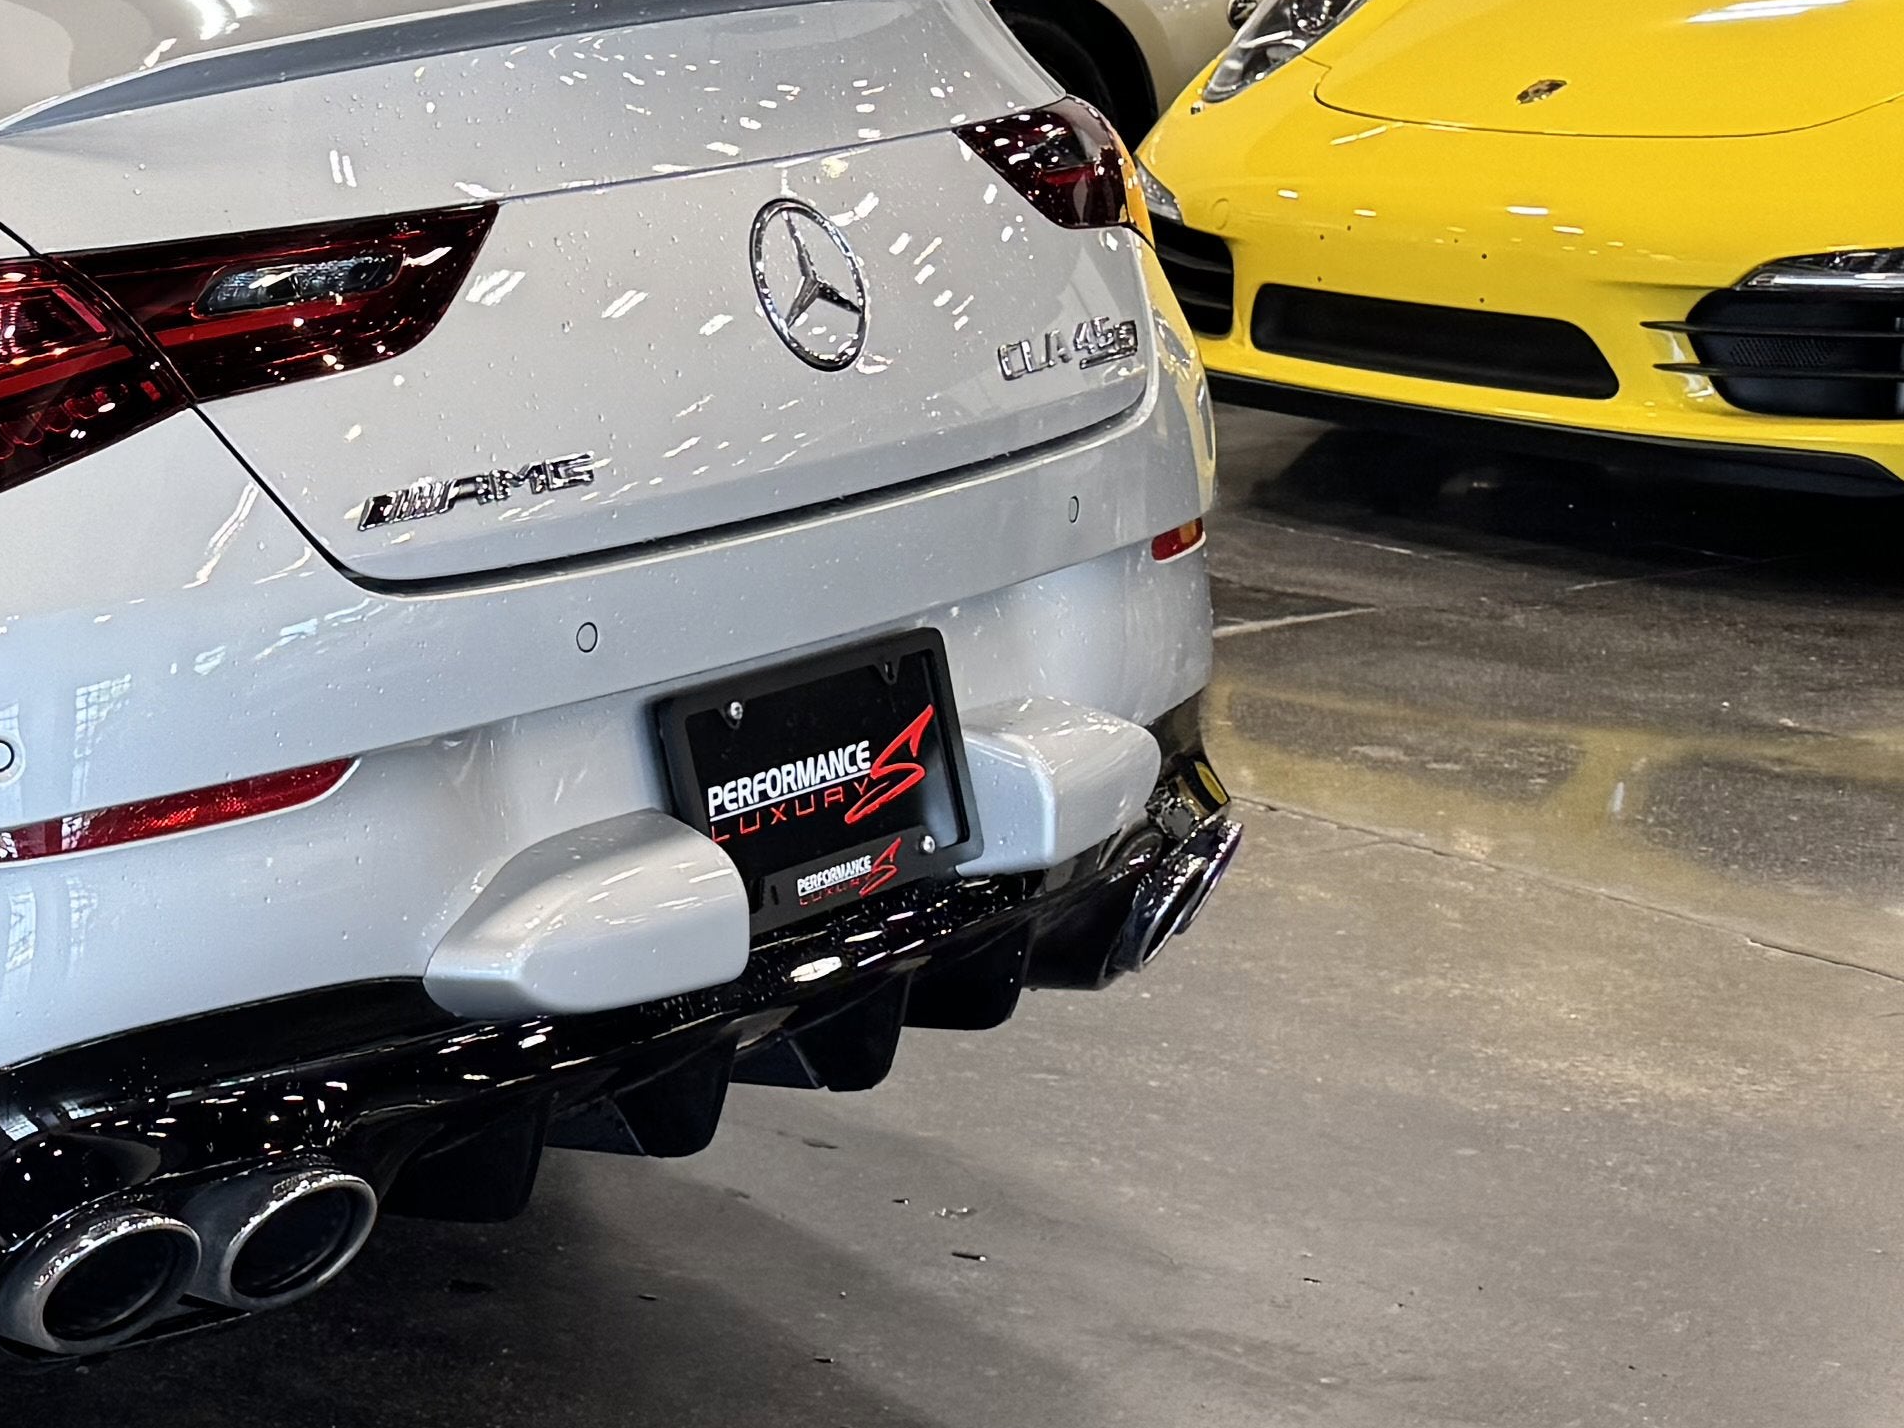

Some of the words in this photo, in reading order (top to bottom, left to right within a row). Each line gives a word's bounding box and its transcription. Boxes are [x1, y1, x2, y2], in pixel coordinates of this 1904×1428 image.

[707, 740, 872, 818] PERFORMANCE
[710, 776, 869, 843] LUXURY
[797, 855, 872, 896] PERFORMANCE
